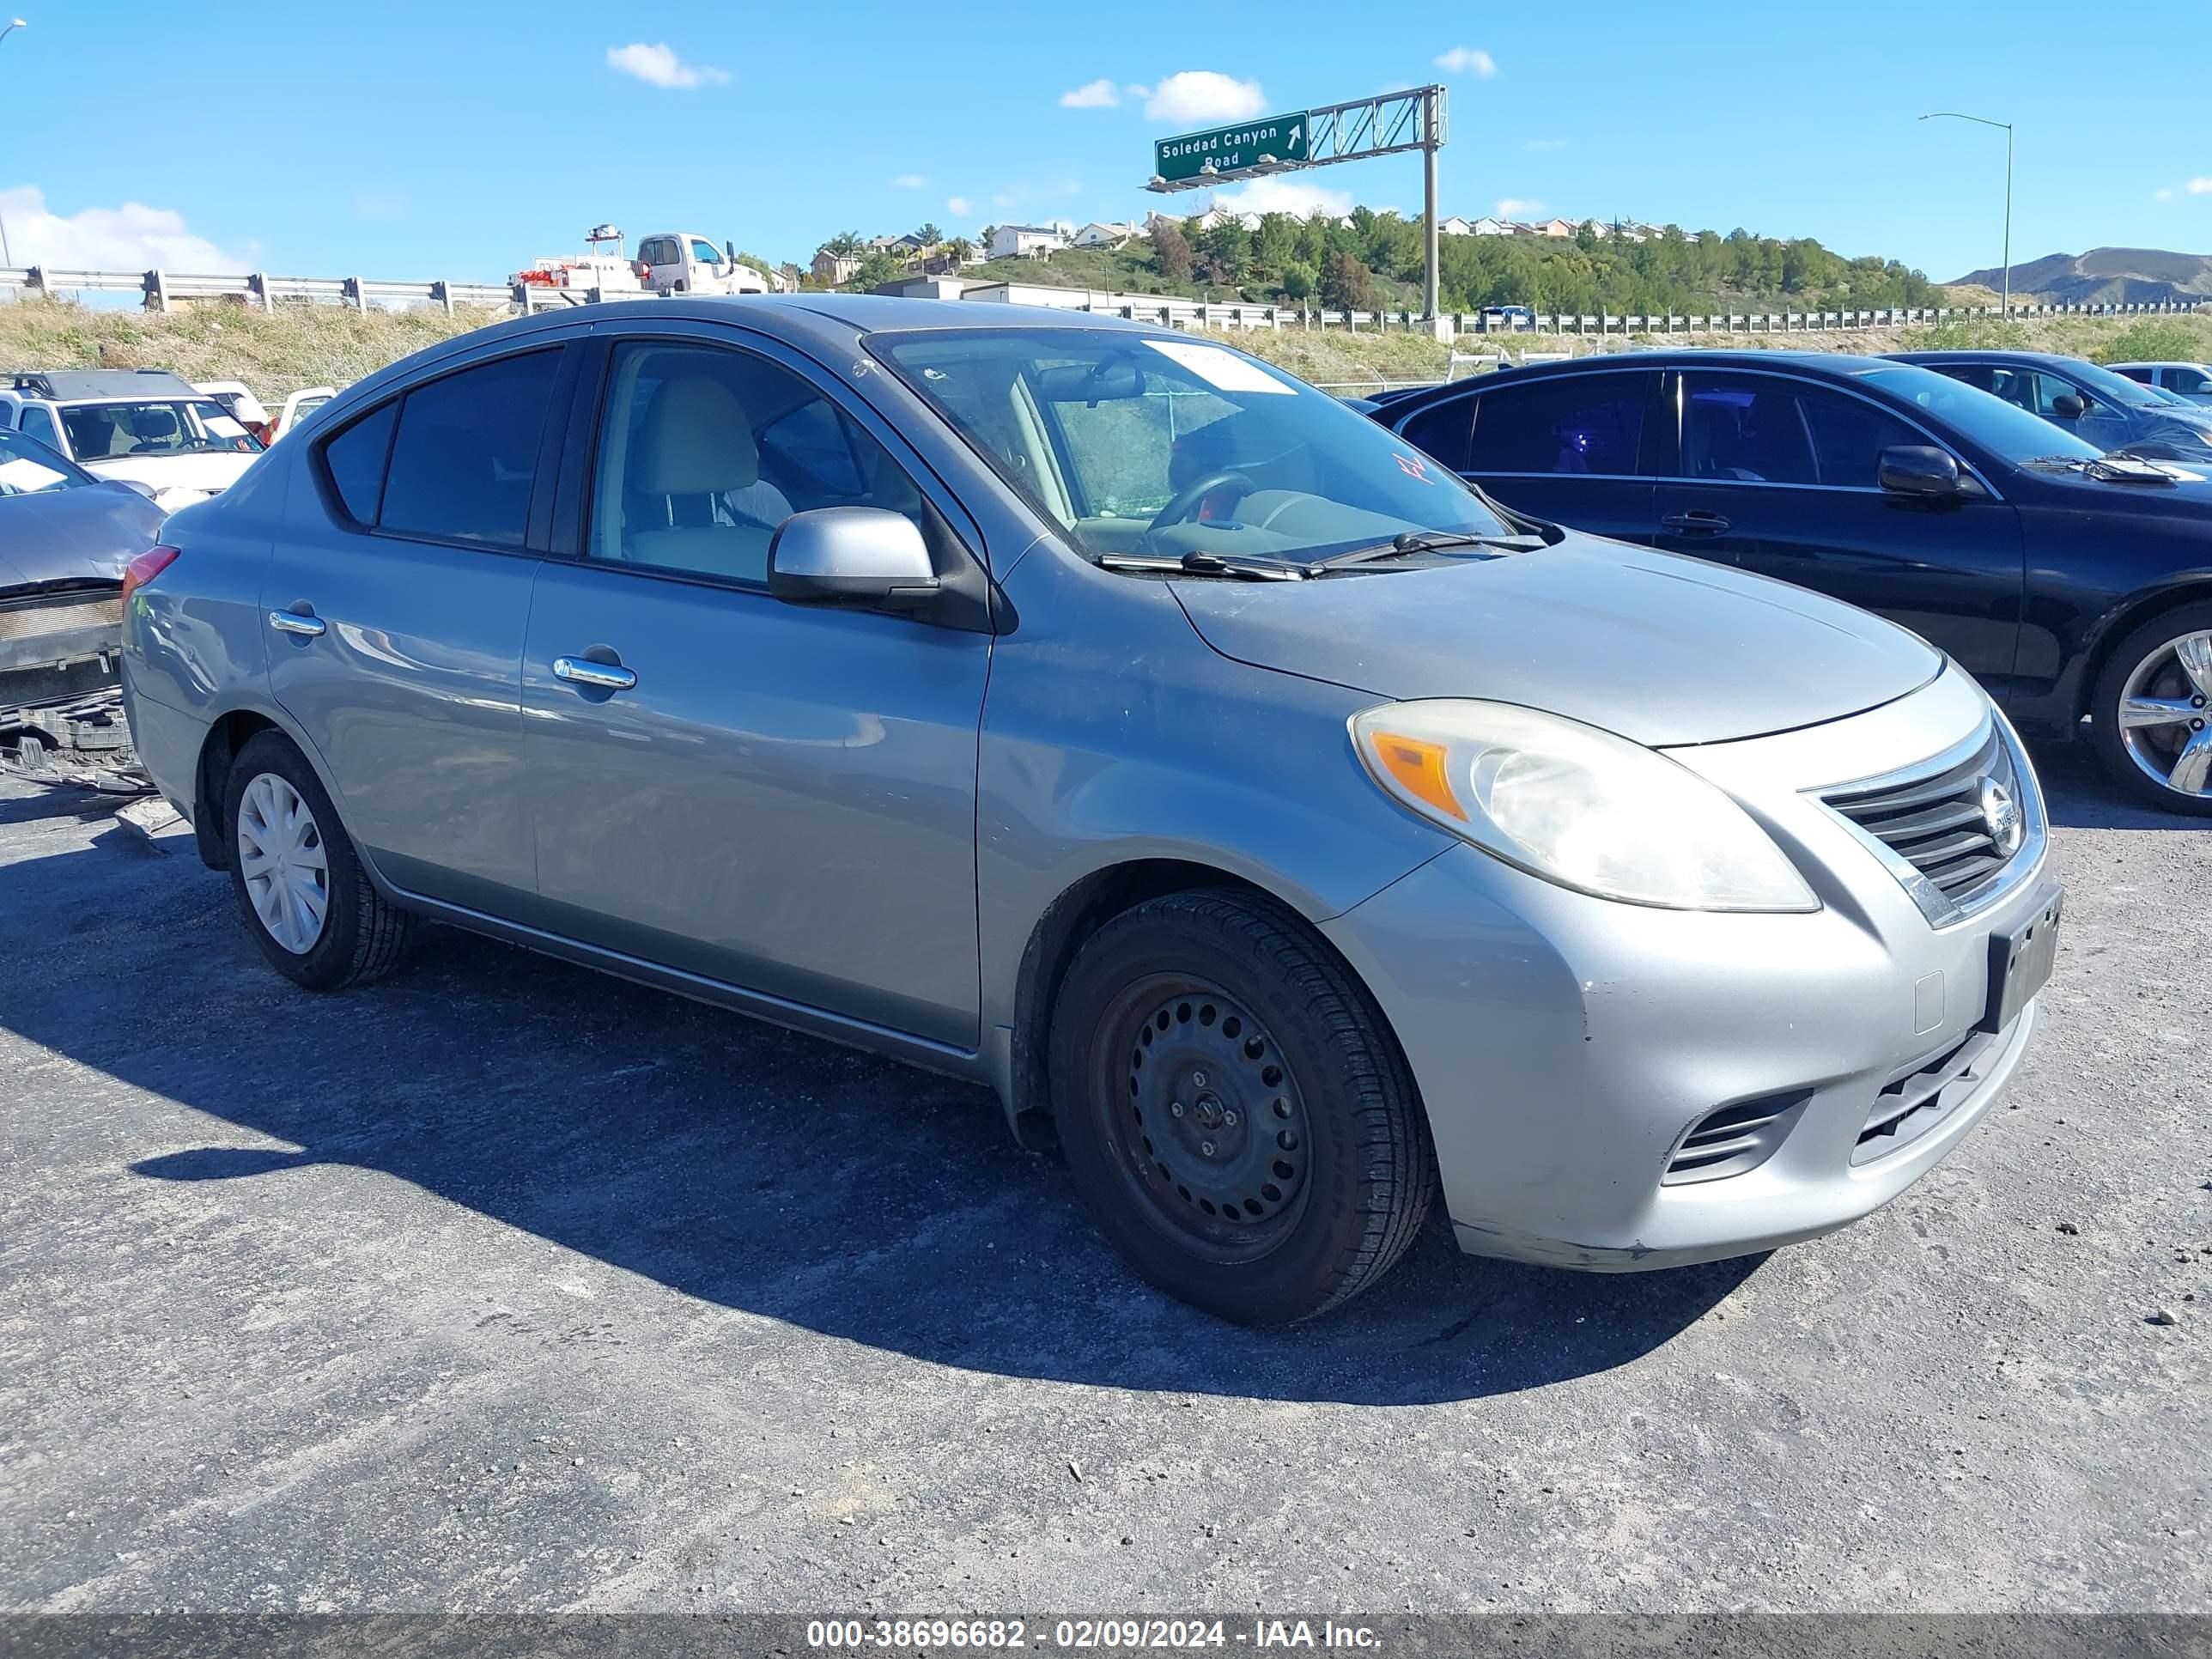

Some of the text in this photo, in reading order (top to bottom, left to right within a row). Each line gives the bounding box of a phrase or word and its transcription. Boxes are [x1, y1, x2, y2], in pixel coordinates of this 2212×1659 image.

[1162, 127, 1278, 159] Soledad Canyon
[1205, 151, 1240, 169] Road
